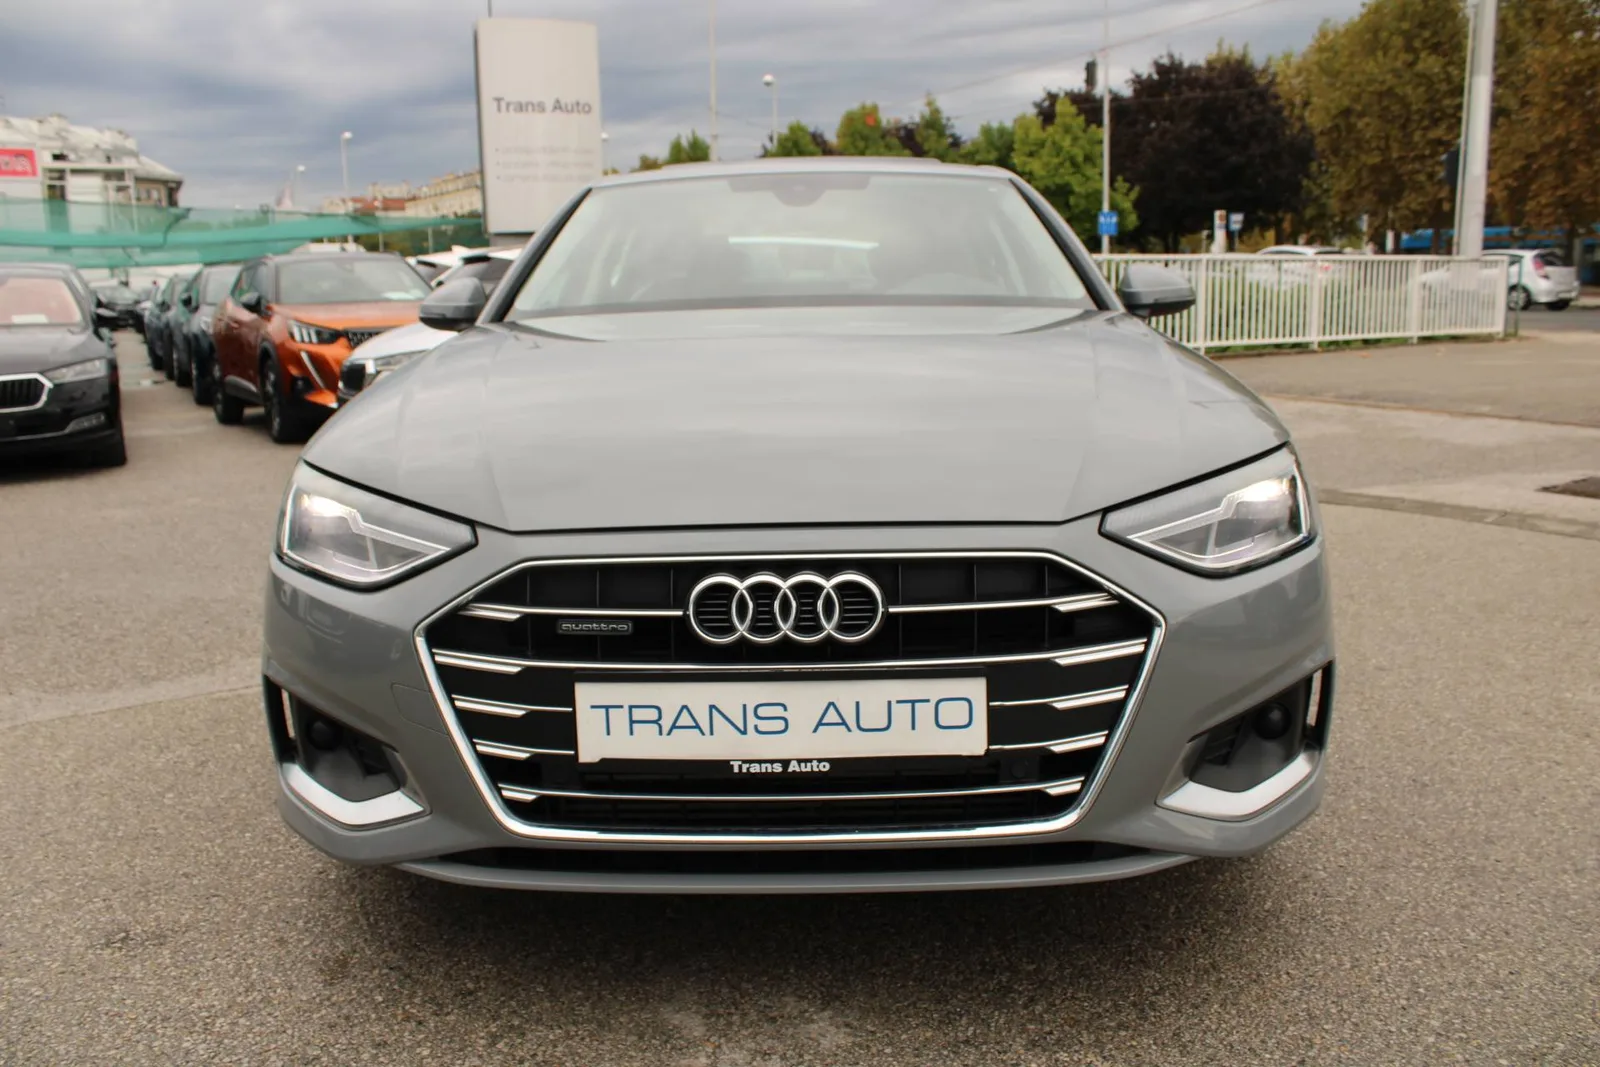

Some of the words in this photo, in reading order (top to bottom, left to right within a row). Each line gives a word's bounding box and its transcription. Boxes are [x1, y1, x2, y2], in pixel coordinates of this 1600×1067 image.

[492, 97, 546, 113] Trans
[551, 98, 592, 114] Auto
[561, 623, 629, 631] quattro
[590, 702, 789, 736] TRANS
[812, 696, 974, 734] AUTO
[730, 761, 783, 773] Trans
[787, 760, 831, 772] Auto
